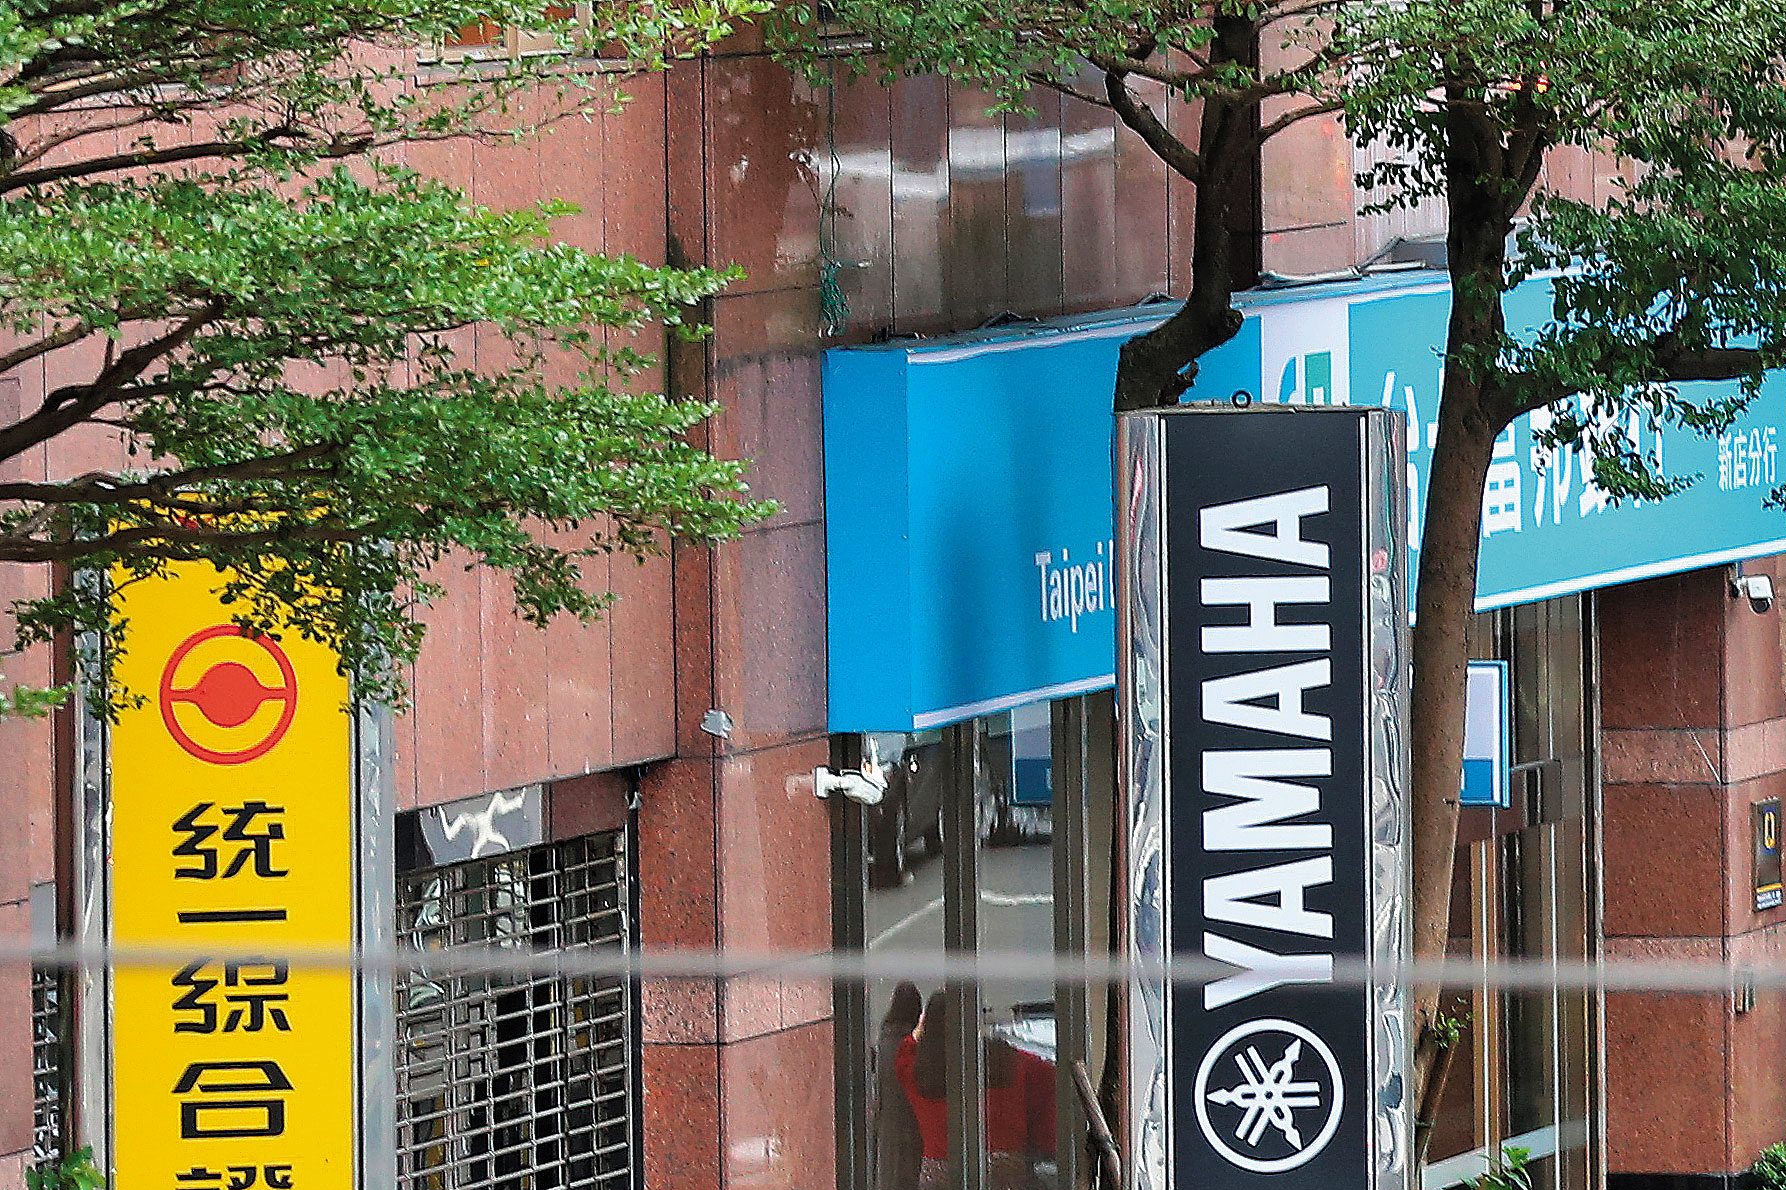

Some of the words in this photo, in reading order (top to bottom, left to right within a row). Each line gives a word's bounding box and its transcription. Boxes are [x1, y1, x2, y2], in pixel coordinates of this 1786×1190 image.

[1718, 425, 1777, 491] 新店分行
[1035, 540, 1104, 634] Taipei
[1200, 482, 1335, 1011] YAMAHA
